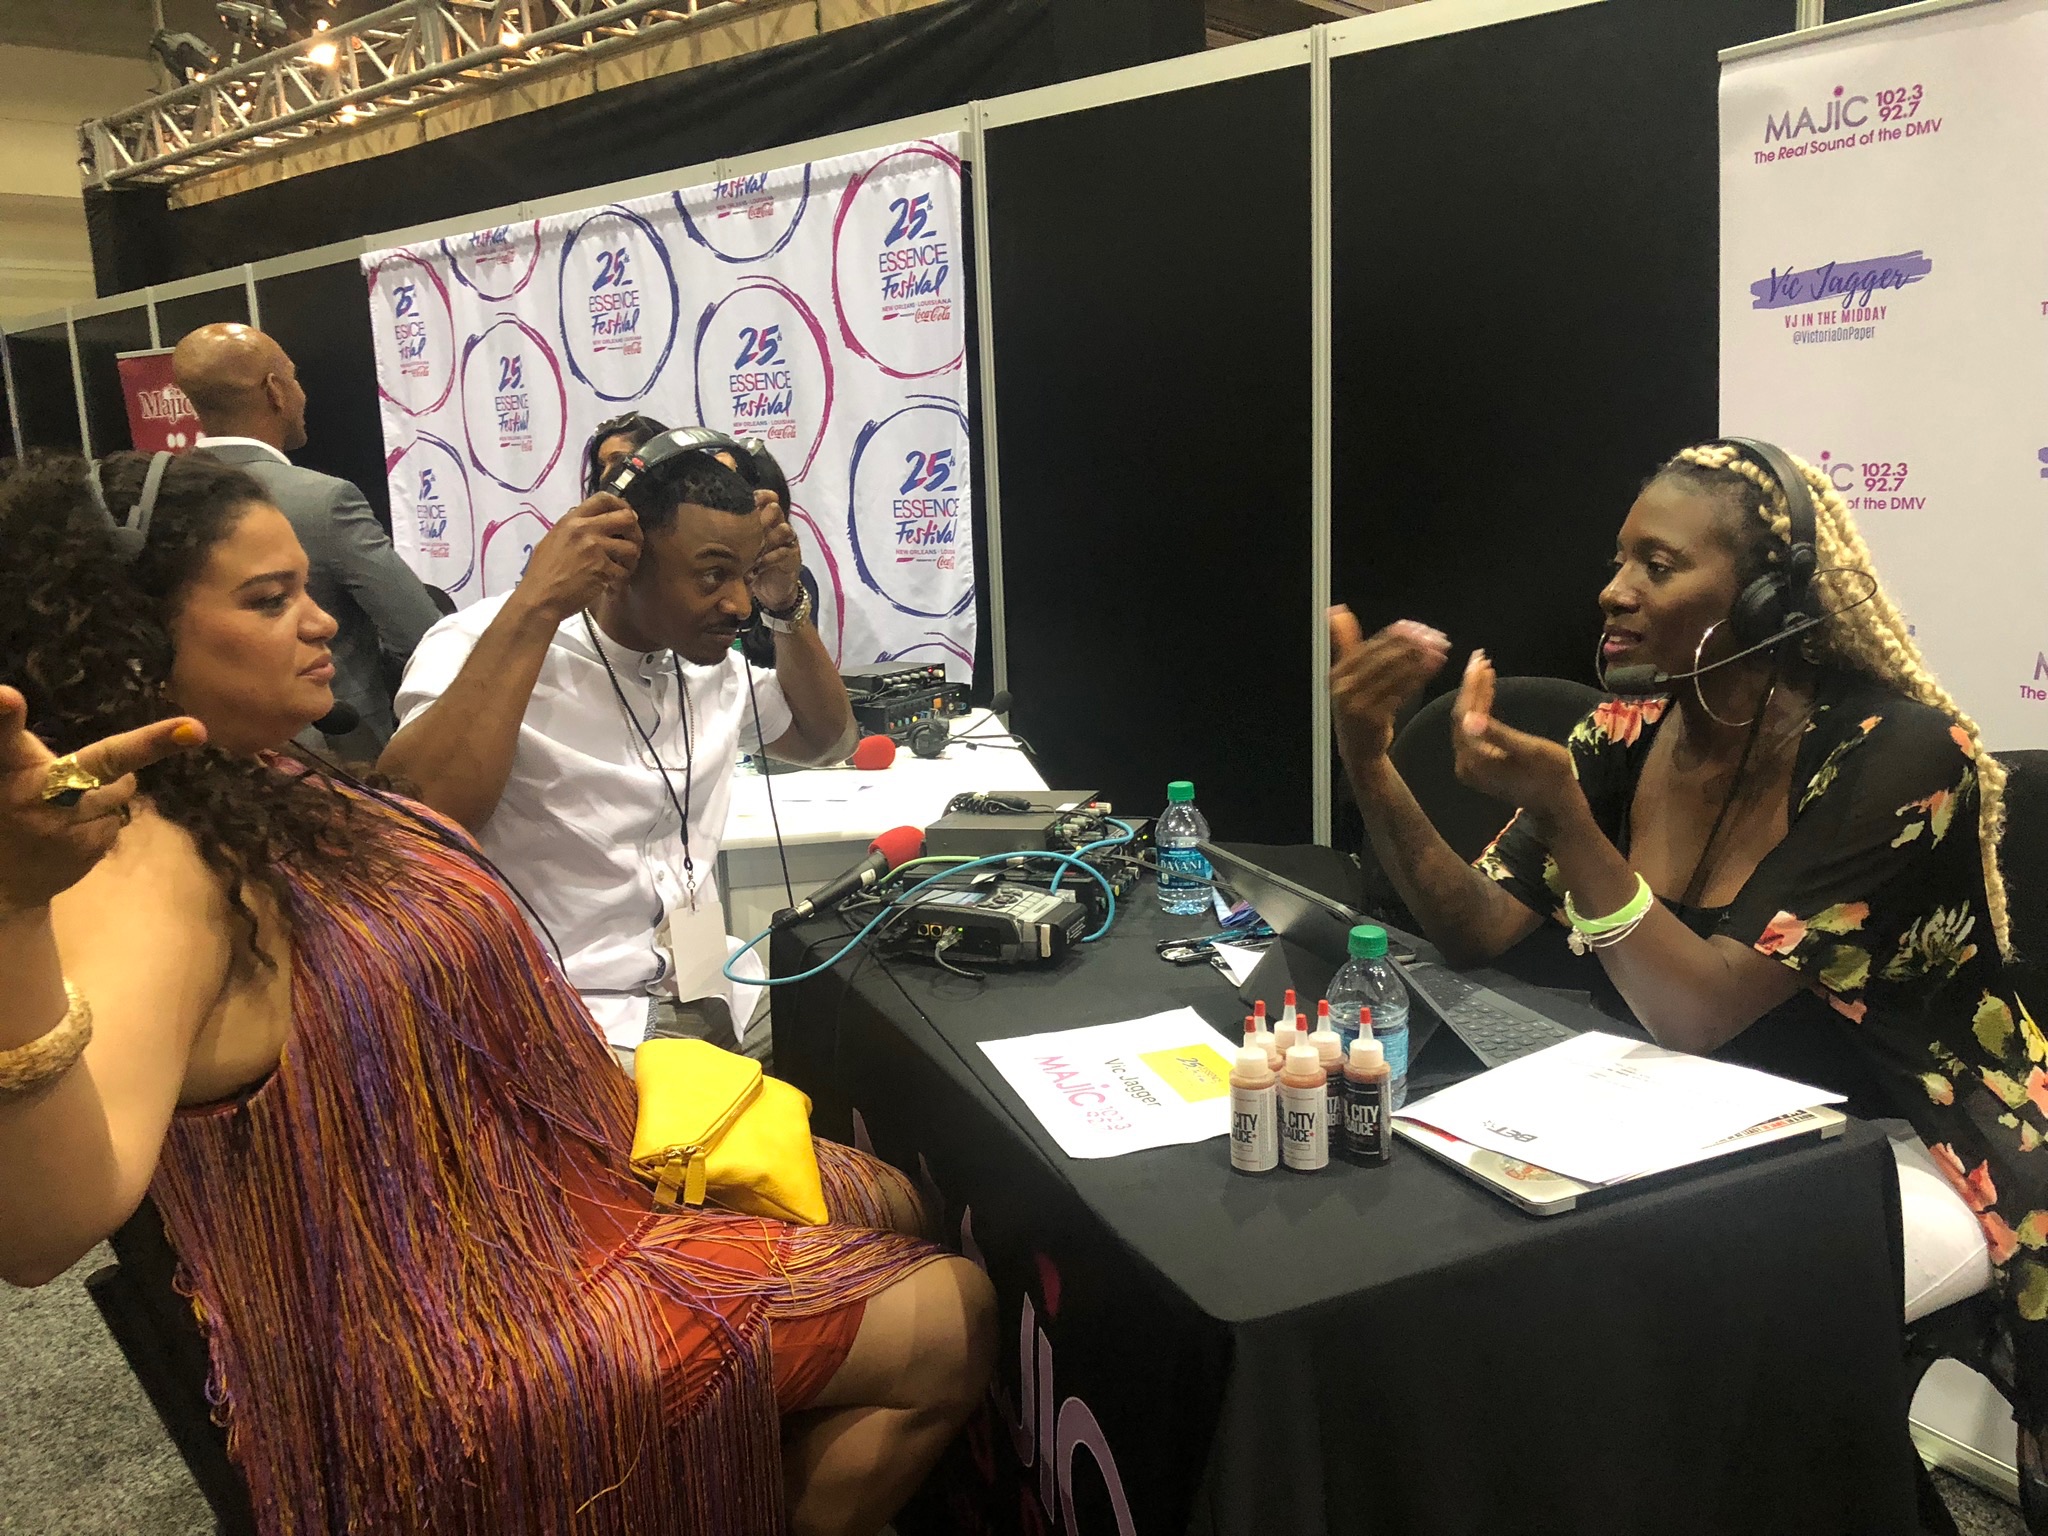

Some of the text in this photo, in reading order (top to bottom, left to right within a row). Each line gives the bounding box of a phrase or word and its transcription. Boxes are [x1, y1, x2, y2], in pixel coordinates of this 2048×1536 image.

[1875, 84, 1923, 106] 102.3
[1878, 101, 1921, 122] 92.7
[1754, 117, 1942, 164] The Real Sound of the DMV
[879, 243, 948, 273] ESSENCE
[881, 264, 949, 301] Festival
[1769, 261, 1910, 309] Vic Jagger
[882, 304, 894, 312] NEW
[1785, 306, 1887, 328] VJ IN THE MIDDAY
[1793, 326, 1875, 345] @VictoriaOnPaper
[729, 371, 792, 392] ESSENCE
[732, 390, 793, 418] Festival
[1861, 463, 1908, 477] 102.3
[1865, 477, 1906, 492] 92.7
[1864, 497, 1887, 510] the
[1891, 497, 1926, 510] DMV
[2020, 685, 2047, 701] The
[1104, 1057, 1126, 1074] Vic
[1119, 1075, 1162, 1107] Jagger
[1234, 1111, 1258, 1131] CITY
[1288, 1111, 1315, 1130] CITY
[1351, 1104, 1379, 1123] CITY
